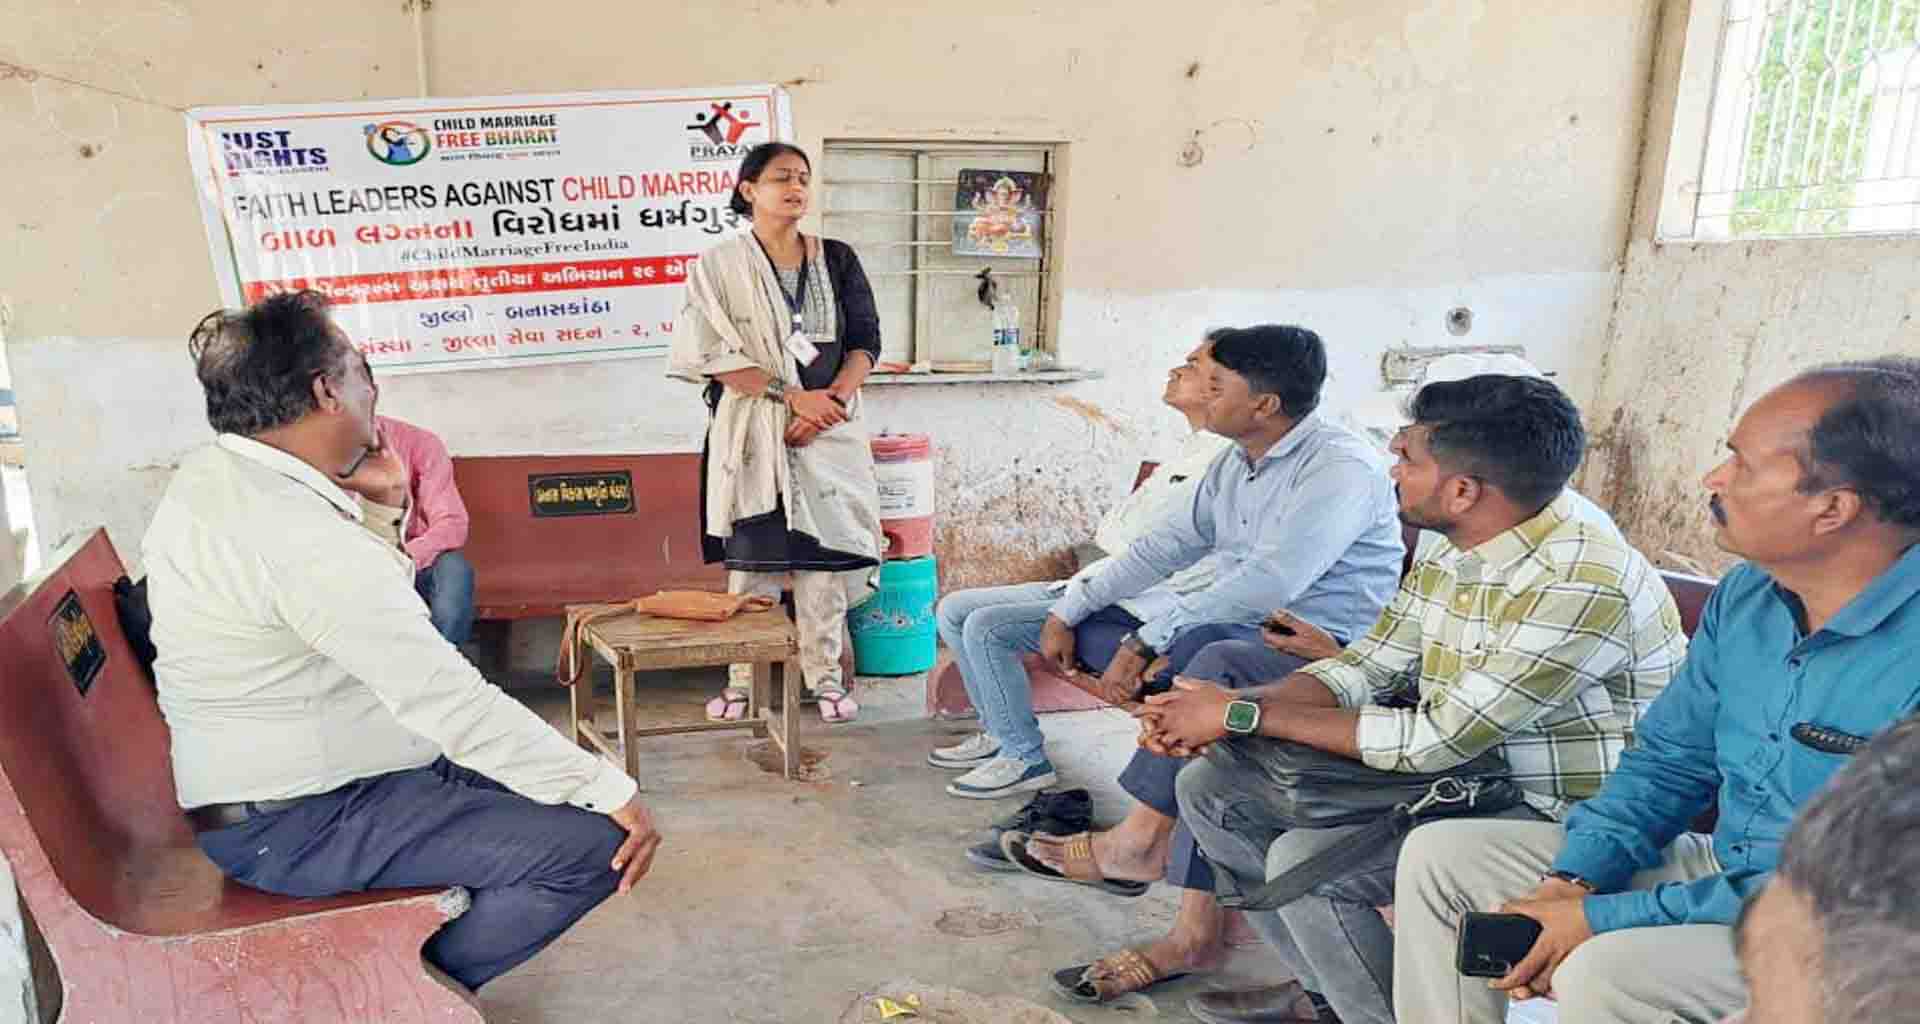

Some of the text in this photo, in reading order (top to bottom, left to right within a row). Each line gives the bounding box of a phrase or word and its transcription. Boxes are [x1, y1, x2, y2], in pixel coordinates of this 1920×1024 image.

[434, 114, 556, 131] CHILD MARRIAGE
[436, 129, 558, 148] FREE BHARAT
[690, 144, 754, 158] PRAYA
[313, 184, 437, 215] LEADERS
[445, 178, 555, 207] AGAINST
[562, 174, 635, 201] CHILD
[641, 170, 742, 198] MARRIA
[493, 204, 620, 236] વિરોધમાં
[504, 297, 612, 319] બનાસકાંઠા
[507, 328, 545, 346] સેવા
[556, 328, 603, 343] સદન
